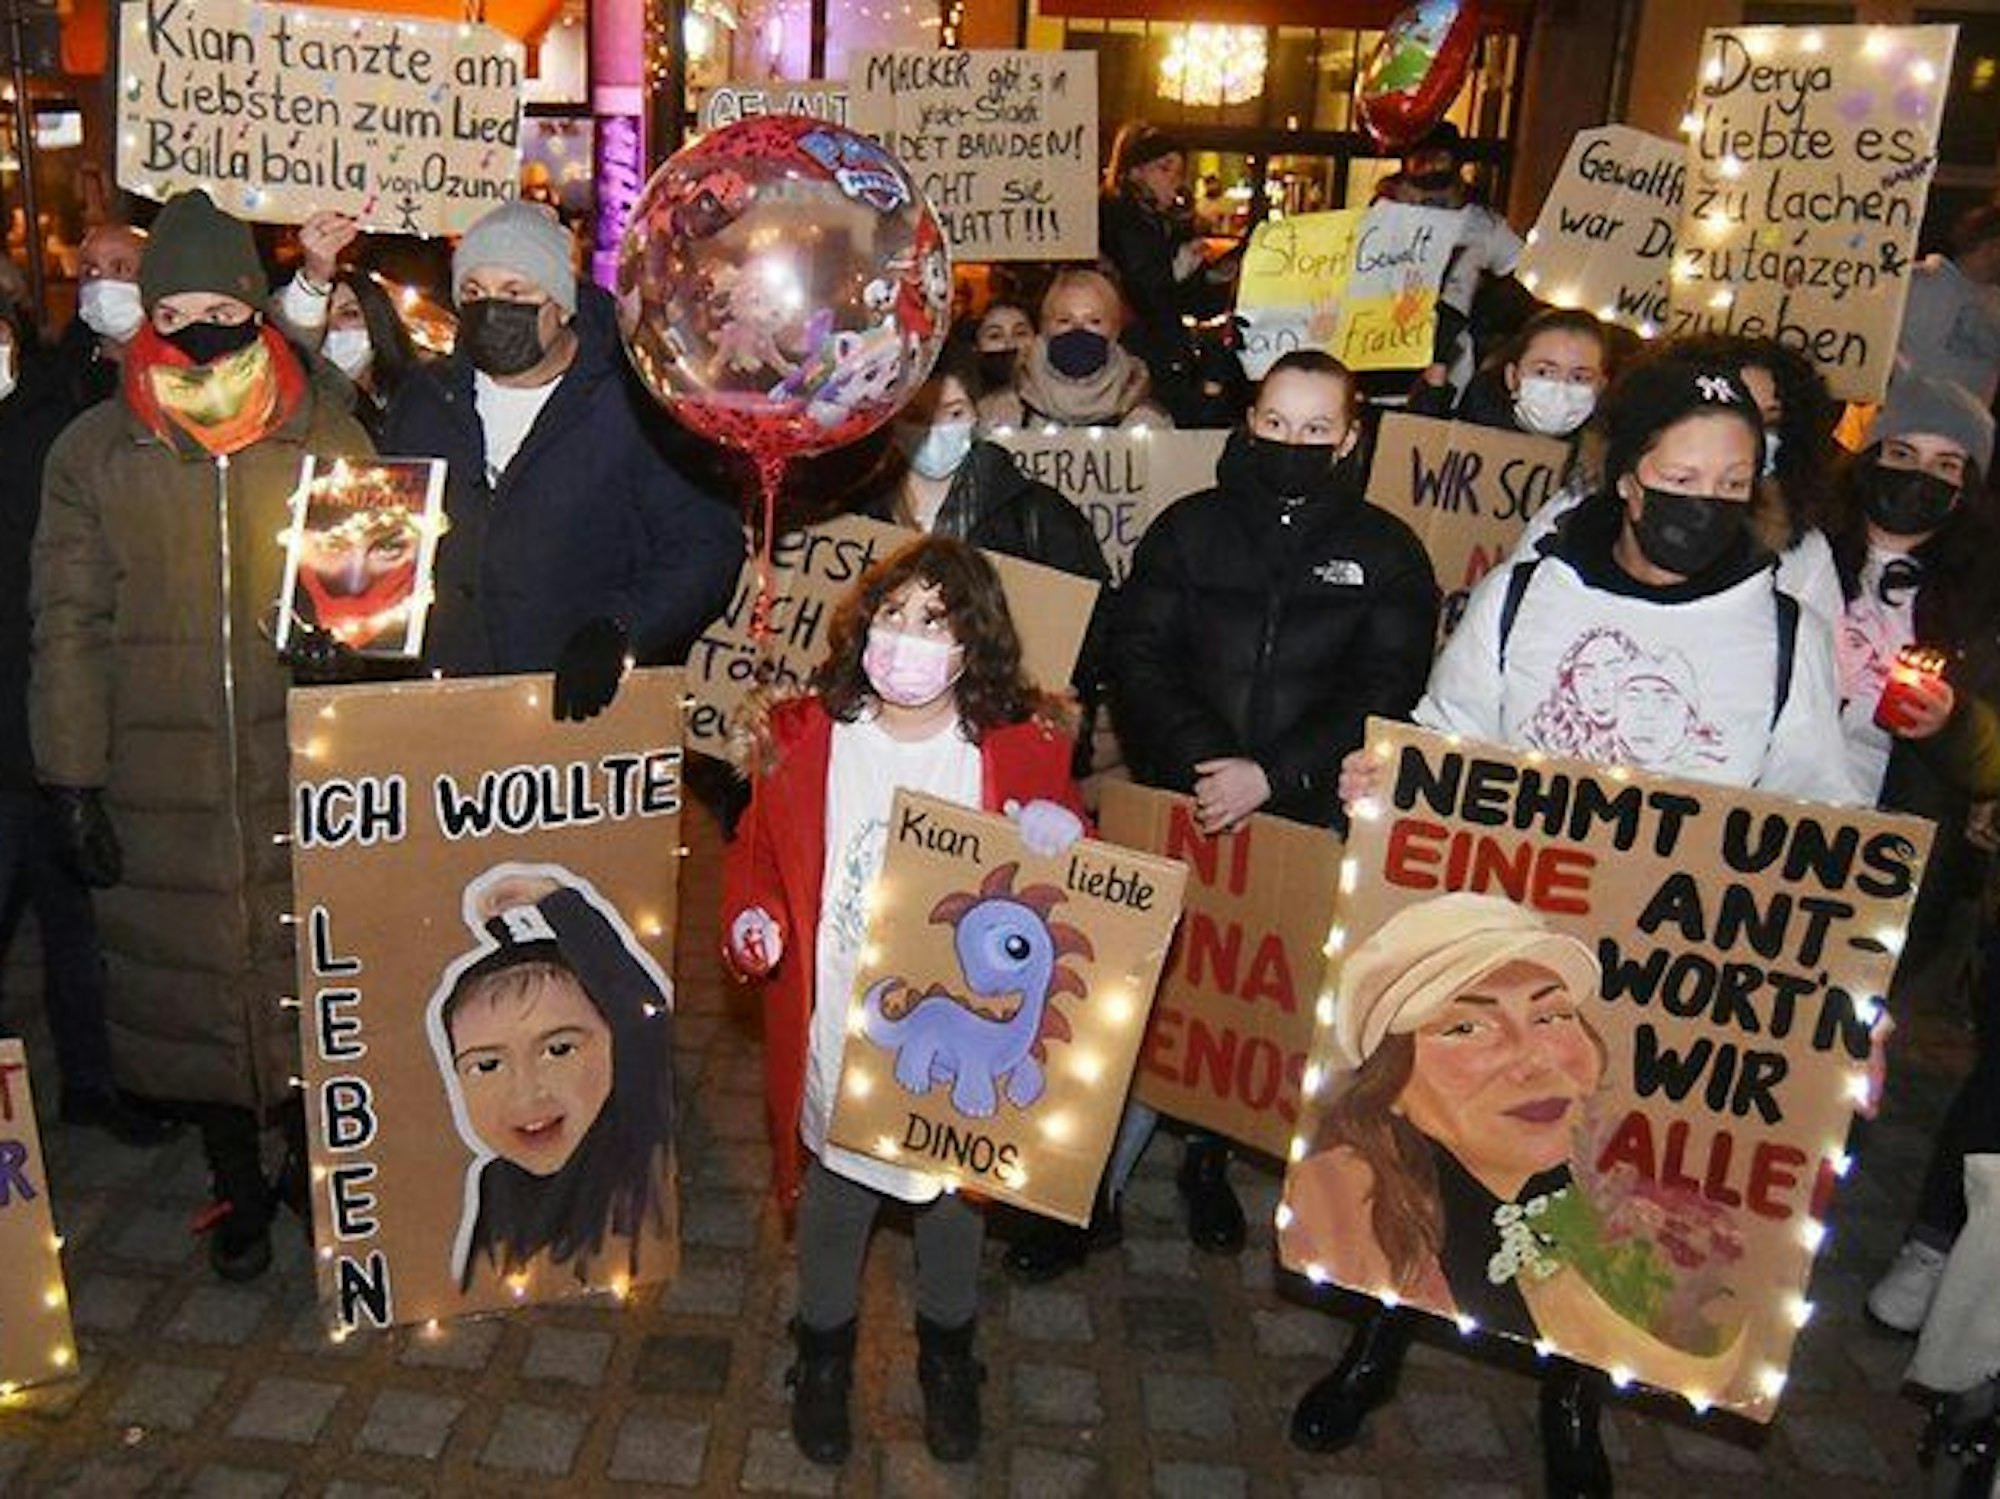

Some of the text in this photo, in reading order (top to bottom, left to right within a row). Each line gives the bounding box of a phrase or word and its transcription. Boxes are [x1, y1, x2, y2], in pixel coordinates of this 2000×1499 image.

[146, 0, 518, 88] Kian tanzte am
[1703, 34, 1833, 114] Derya
[353, 101, 441, 138] zum
[451, 97, 520, 148] Lied
[957, 124, 1086, 161] BANDEN!
[1699, 100, 1917, 163] liebte es
[377, 171, 420, 194] von
[1692, 169, 1917, 225] zu lachen
[1561, 206, 1623, 243] war
[1684, 231, 1908, 291] zu tanzen &
[1413, 446, 1483, 516] WIR
[299, 752, 682, 845] ICH WOLLTE
[1392, 746, 1916, 898] NEHMT UNS
[900, 807, 1154, 911] Kian liebte
[1384, 819, 1597, 917] EINE
[1633, 1023, 1789, 1125] WIR
[311, 907, 392, 1328] LEBEN
[903, 1113, 1019, 1180] DINOS
